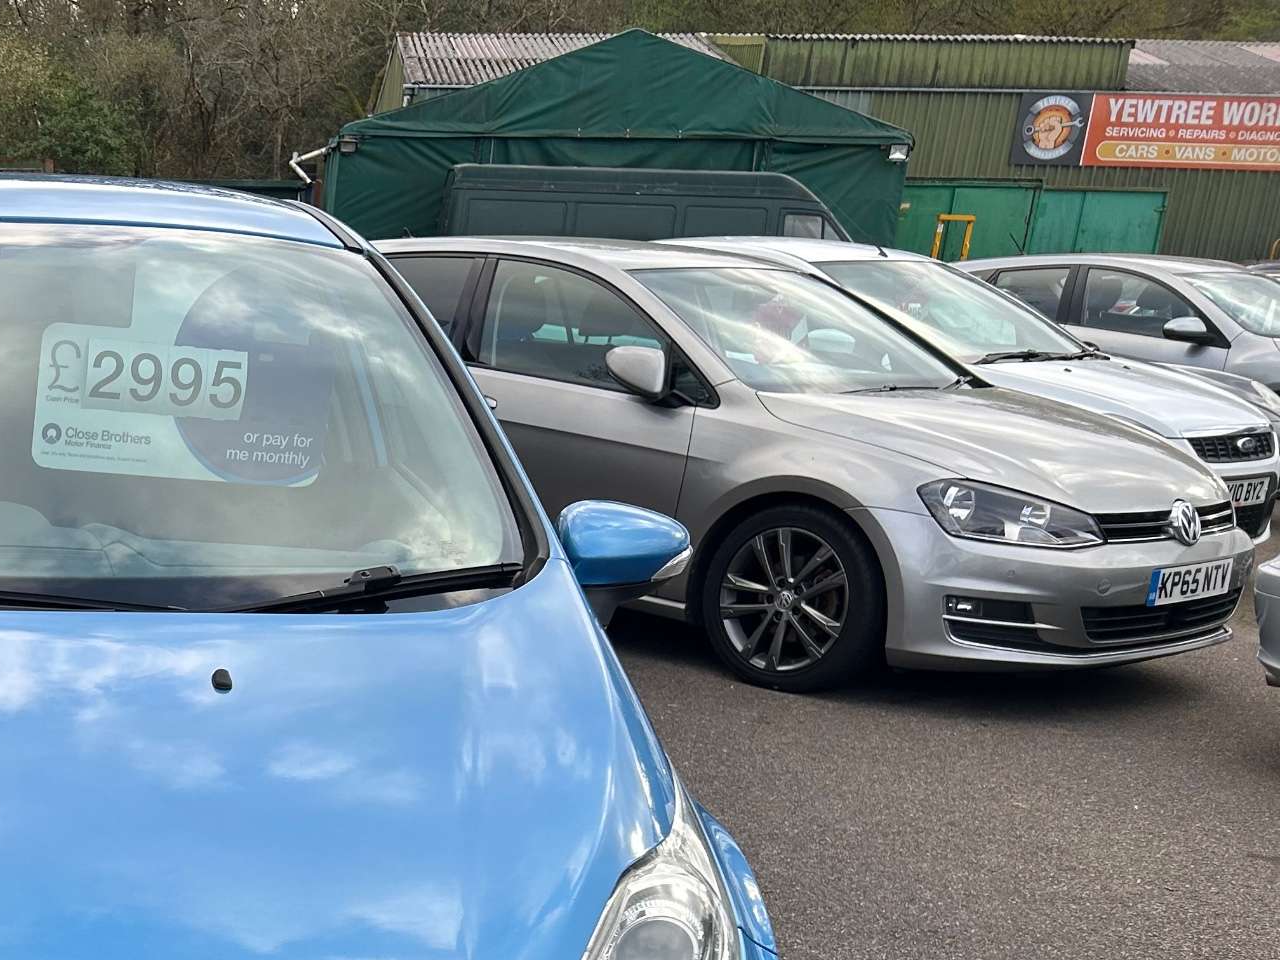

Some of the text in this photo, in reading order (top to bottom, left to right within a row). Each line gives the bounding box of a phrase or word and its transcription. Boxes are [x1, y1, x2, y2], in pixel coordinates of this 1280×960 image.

[1108, 98, 1217, 125] YEWTREE
[1105, 126, 1166, 138] SERVICING
[1177, 128, 1227, 140] REPAIRS
[1115, 144, 1280, 161] CARS VANS MOTO
[64, 439, 112, 450] Motor Finance
[65, 426, 152, 446] Close Brothers
[243, 432, 313, 449] or pay for
[226, 448, 310, 469] me monthly
[1244, 481, 1265, 501] BYZ
[1159, 562, 1230, 599] KP65 NTV
